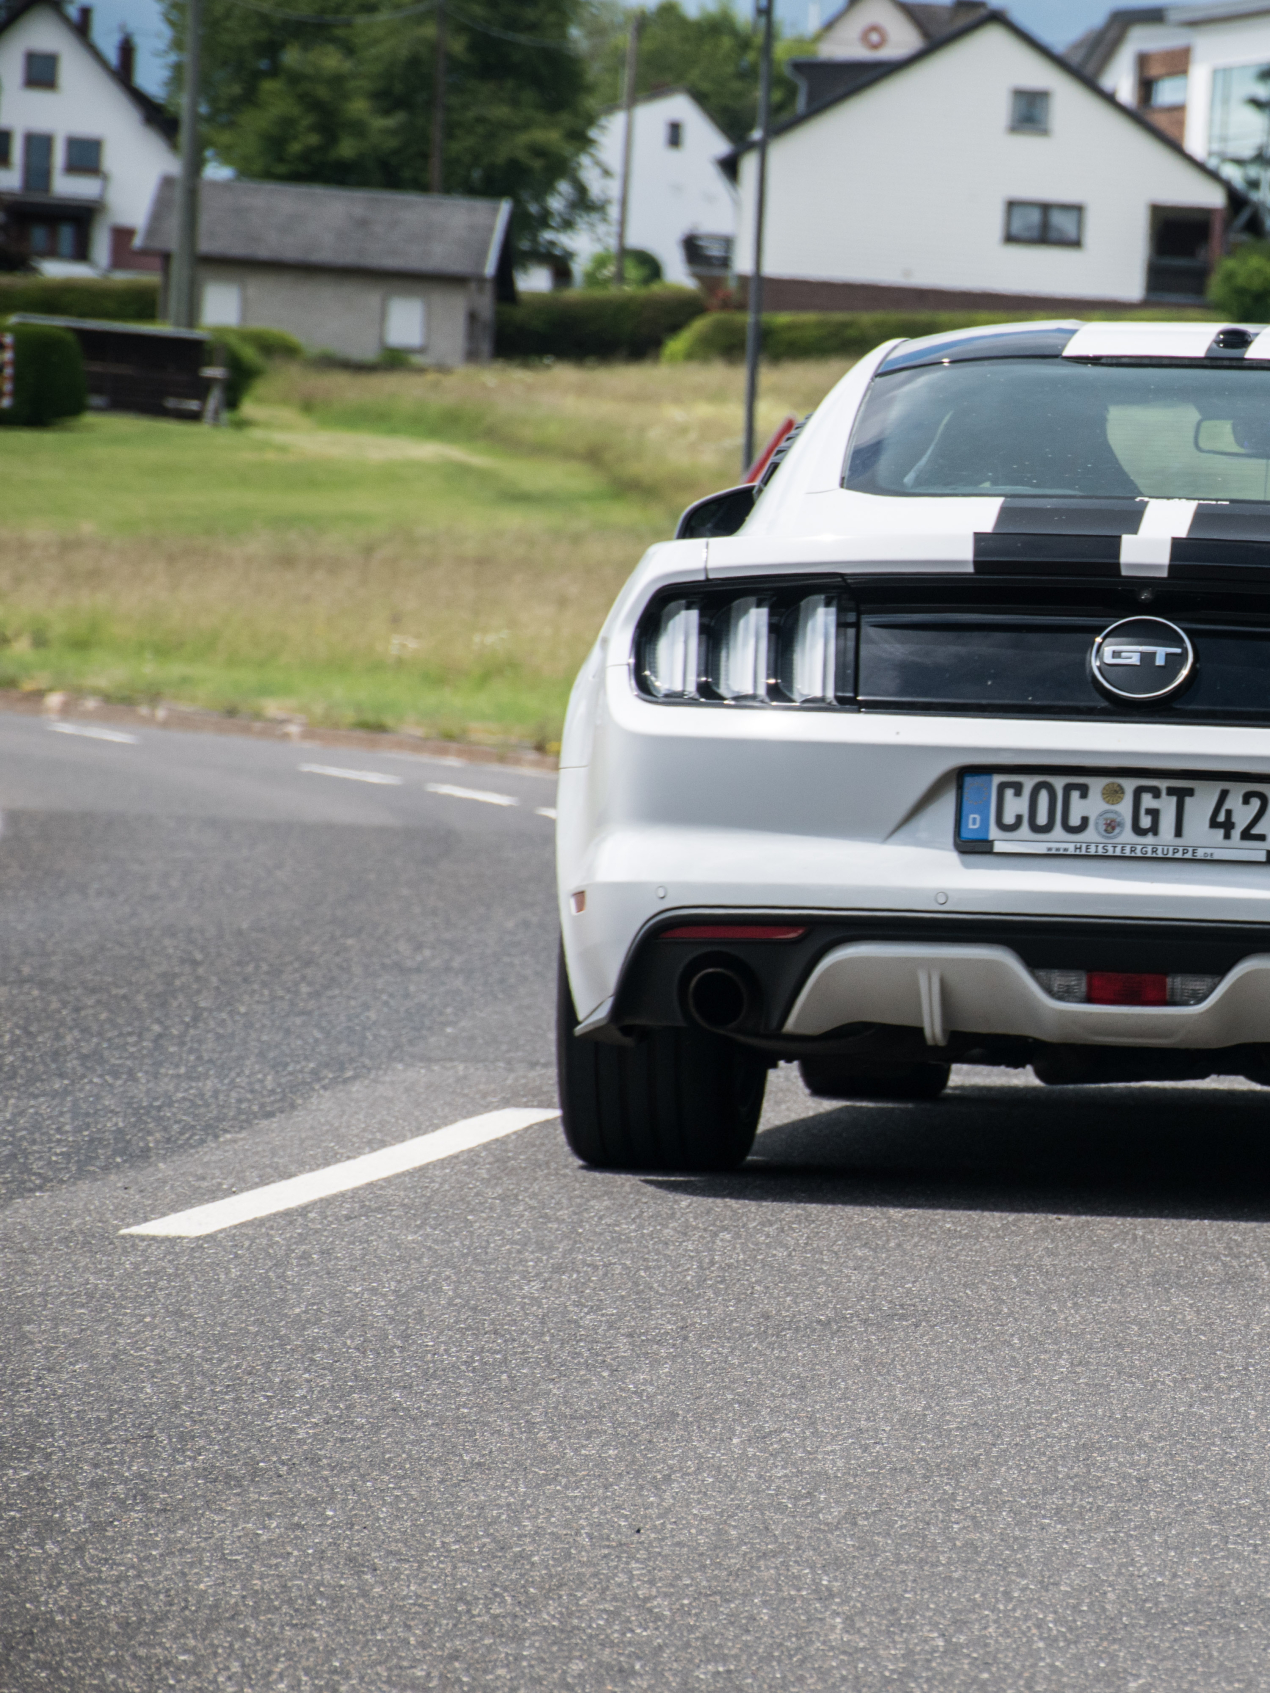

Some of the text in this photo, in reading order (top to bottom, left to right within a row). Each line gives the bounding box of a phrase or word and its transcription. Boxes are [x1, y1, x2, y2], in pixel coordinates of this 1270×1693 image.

[1103, 645, 1182, 666] GT
[995, 780, 1089, 834] COC
[1131, 785, 1195, 838] GT
[968, 814, 981, 829] D
